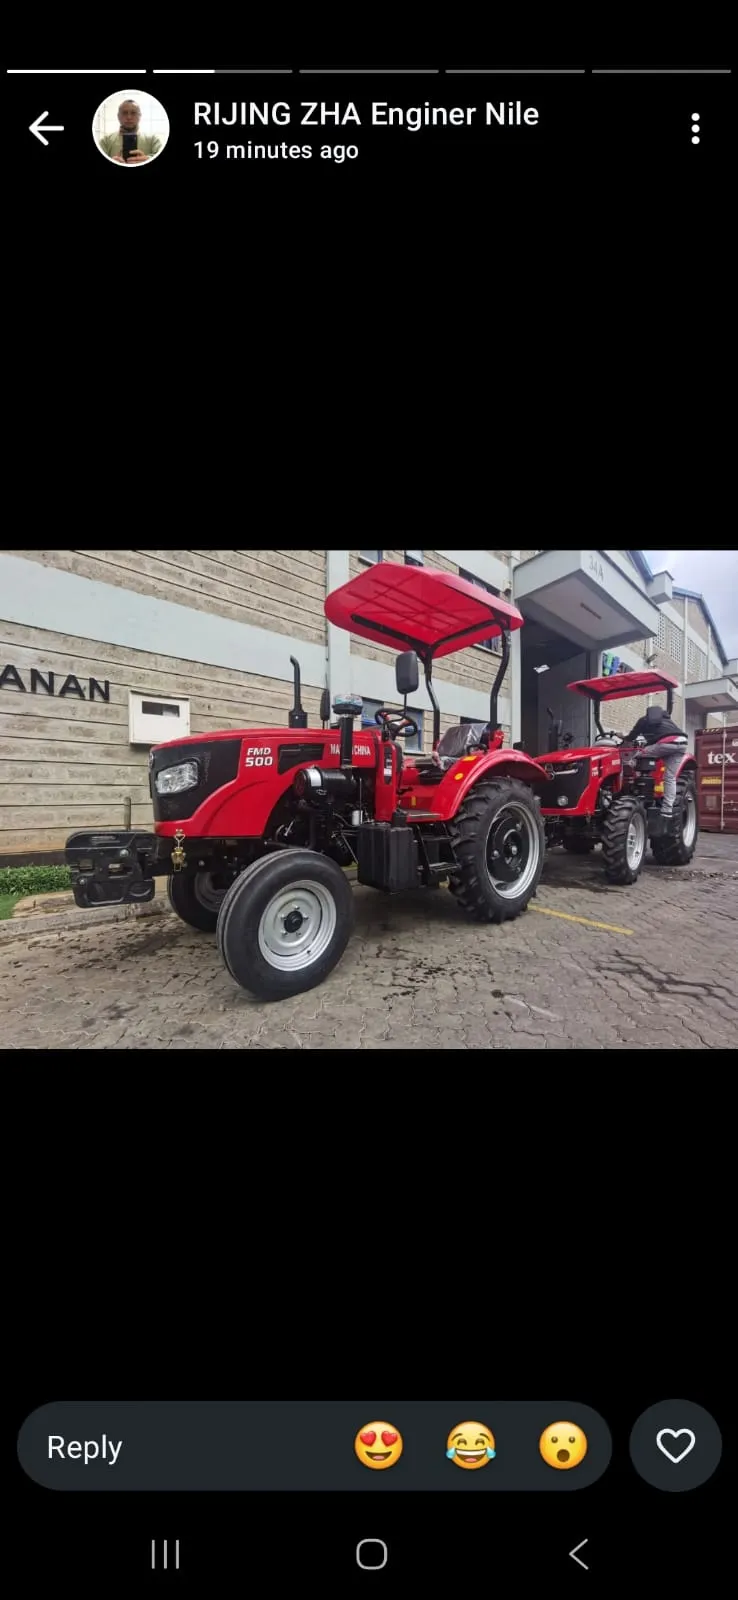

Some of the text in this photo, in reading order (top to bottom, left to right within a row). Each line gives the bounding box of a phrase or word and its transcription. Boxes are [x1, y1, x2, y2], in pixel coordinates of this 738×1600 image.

[246, 747, 272, 756] FMD
[353, 744, 371, 756] CHINA
[245, 756, 273, 767] 500
[707, 751, 737, 765] tex
